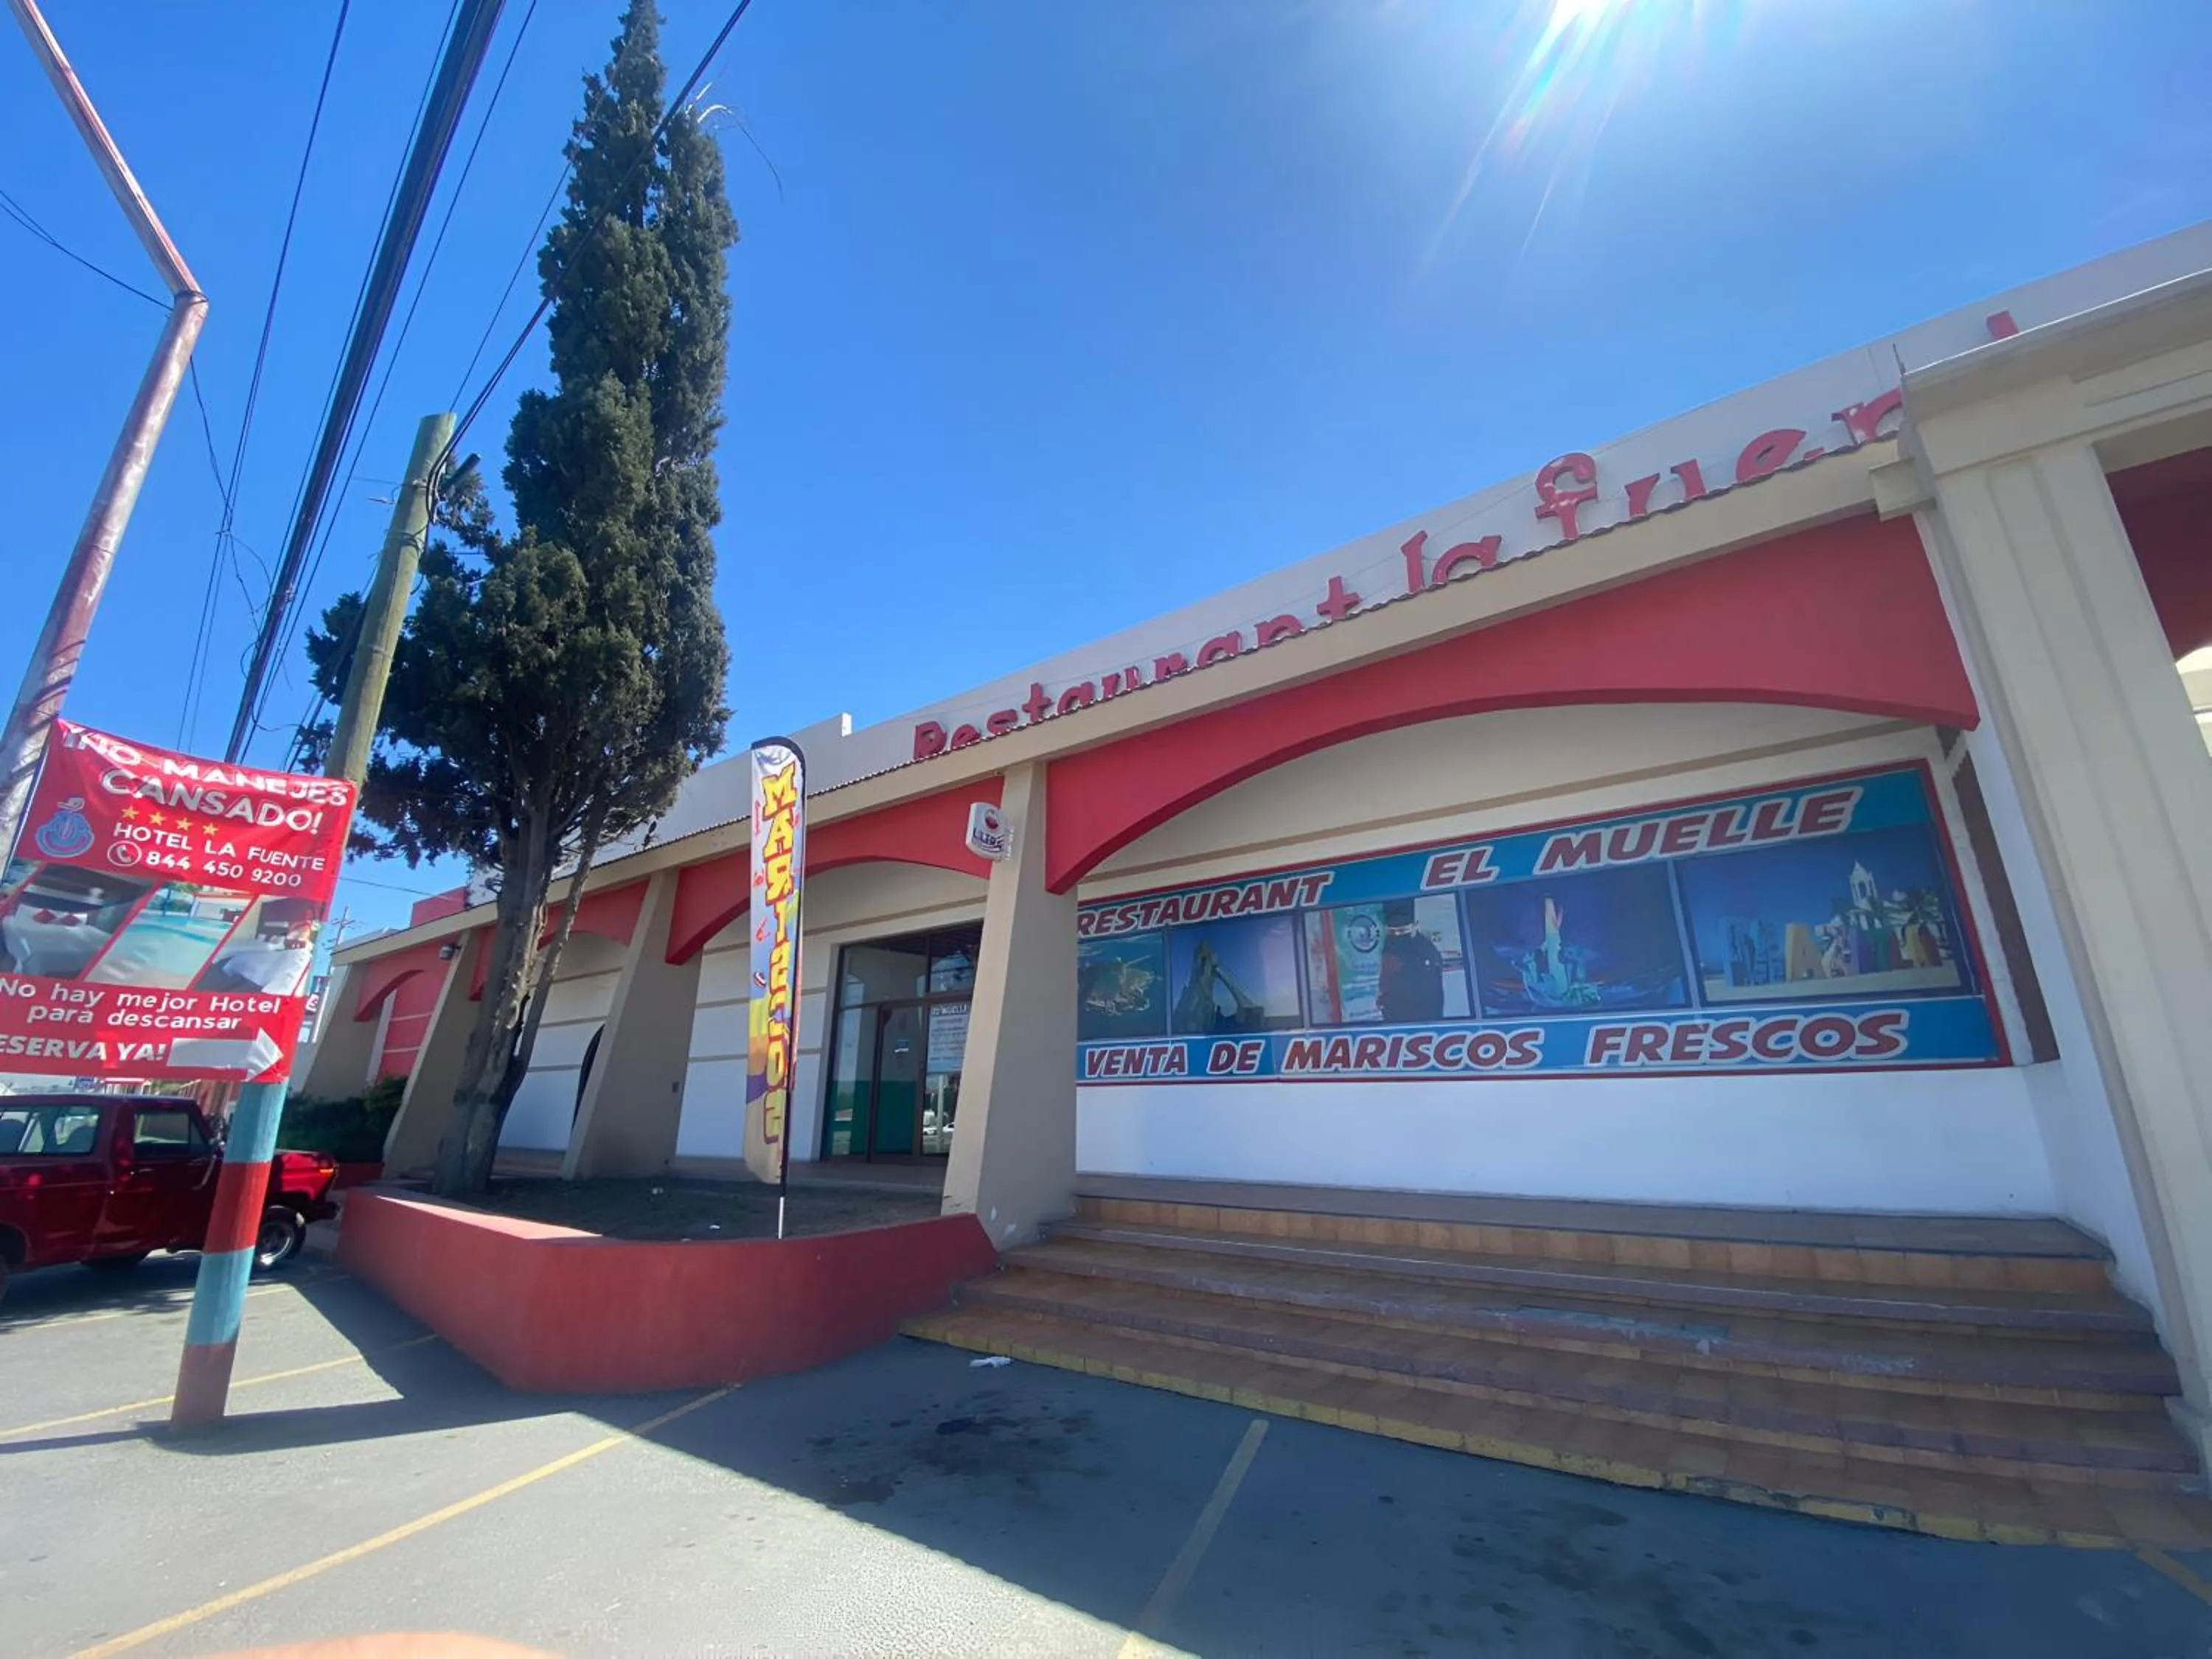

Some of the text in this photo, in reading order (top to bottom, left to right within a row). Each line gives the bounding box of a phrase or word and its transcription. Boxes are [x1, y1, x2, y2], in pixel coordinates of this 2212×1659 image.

[100, 768, 324, 835] CANSADO!
[161, 756, 348, 807] MANEJES
[113, 822, 325, 872] HOTEL LA FUENTE
[1420, 786, 1864, 891] EL MUELLE
[145, 852, 302, 886] 844 450 9200
[1077, 871, 1335, 938] RESTAURANT
[0, 977, 36, 998] No
[49, 982, 106, 1008] hay
[116, 992, 198, 1013] mejor
[209, 996, 281, 1014] Hotel
[26, 1005, 242, 1030] para descansar
[0, 1034, 166, 1061] ESERVA YA!
[1085, 1008, 1910, 1077] VENTA DE MARISCOS FRESCOS
